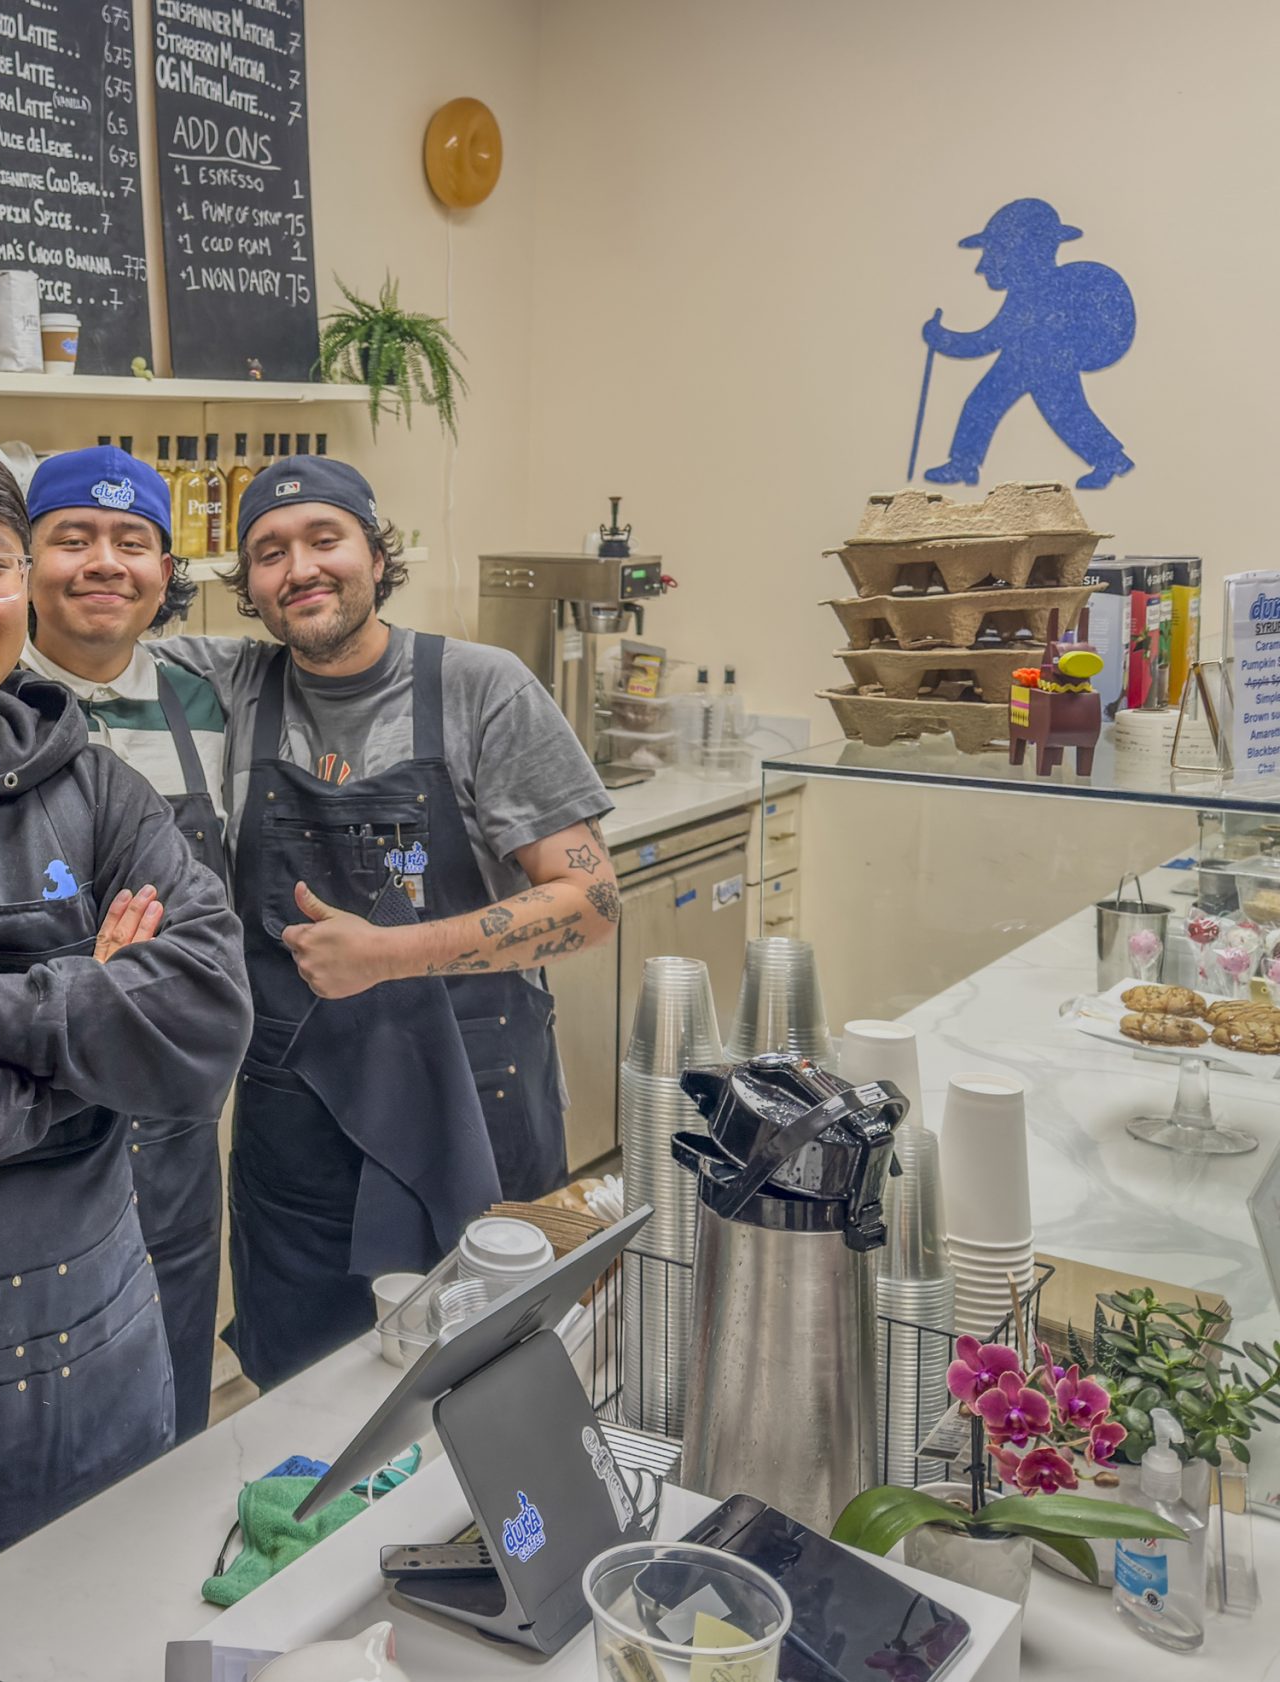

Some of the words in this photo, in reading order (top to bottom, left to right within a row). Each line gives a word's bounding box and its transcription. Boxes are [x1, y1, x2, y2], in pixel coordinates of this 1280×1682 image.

[156, 0, 232, 37] EINSPANNER
[289, 32, 302, 54] 7
[155, 54, 180, 93] OG
[180, 60, 223, 104] MATCHA
[287, 101, 303, 126] 7
[289, 69, 302, 90] 7
[173, 115, 219, 155] ADD
[225, 126, 273, 165] ONS
[120, 177, 136, 197] 7
[199, 166, 265, 193] ESPRESSO
[291, 179, 305, 200] 1
[100, 213, 113, 235] 7
[201, 200, 234, 225] PUMP
[234, 205, 250, 225] OF
[251, 208, 283, 228] SYRUP
[28, 240, 63, 265] CHOCO
[201, 235, 234, 253] COLD
[238, 236, 272, 257] FOAM
[290, 240, 308, 262] 1
[201, 266, 236, 293] NON
[238, 266, 281, 298] DAIRY
[109, 288, 124, 311] 7
[1241, 657, 1276, 672] Pumpkin
[1243, 712, 1270, 724] Brown
